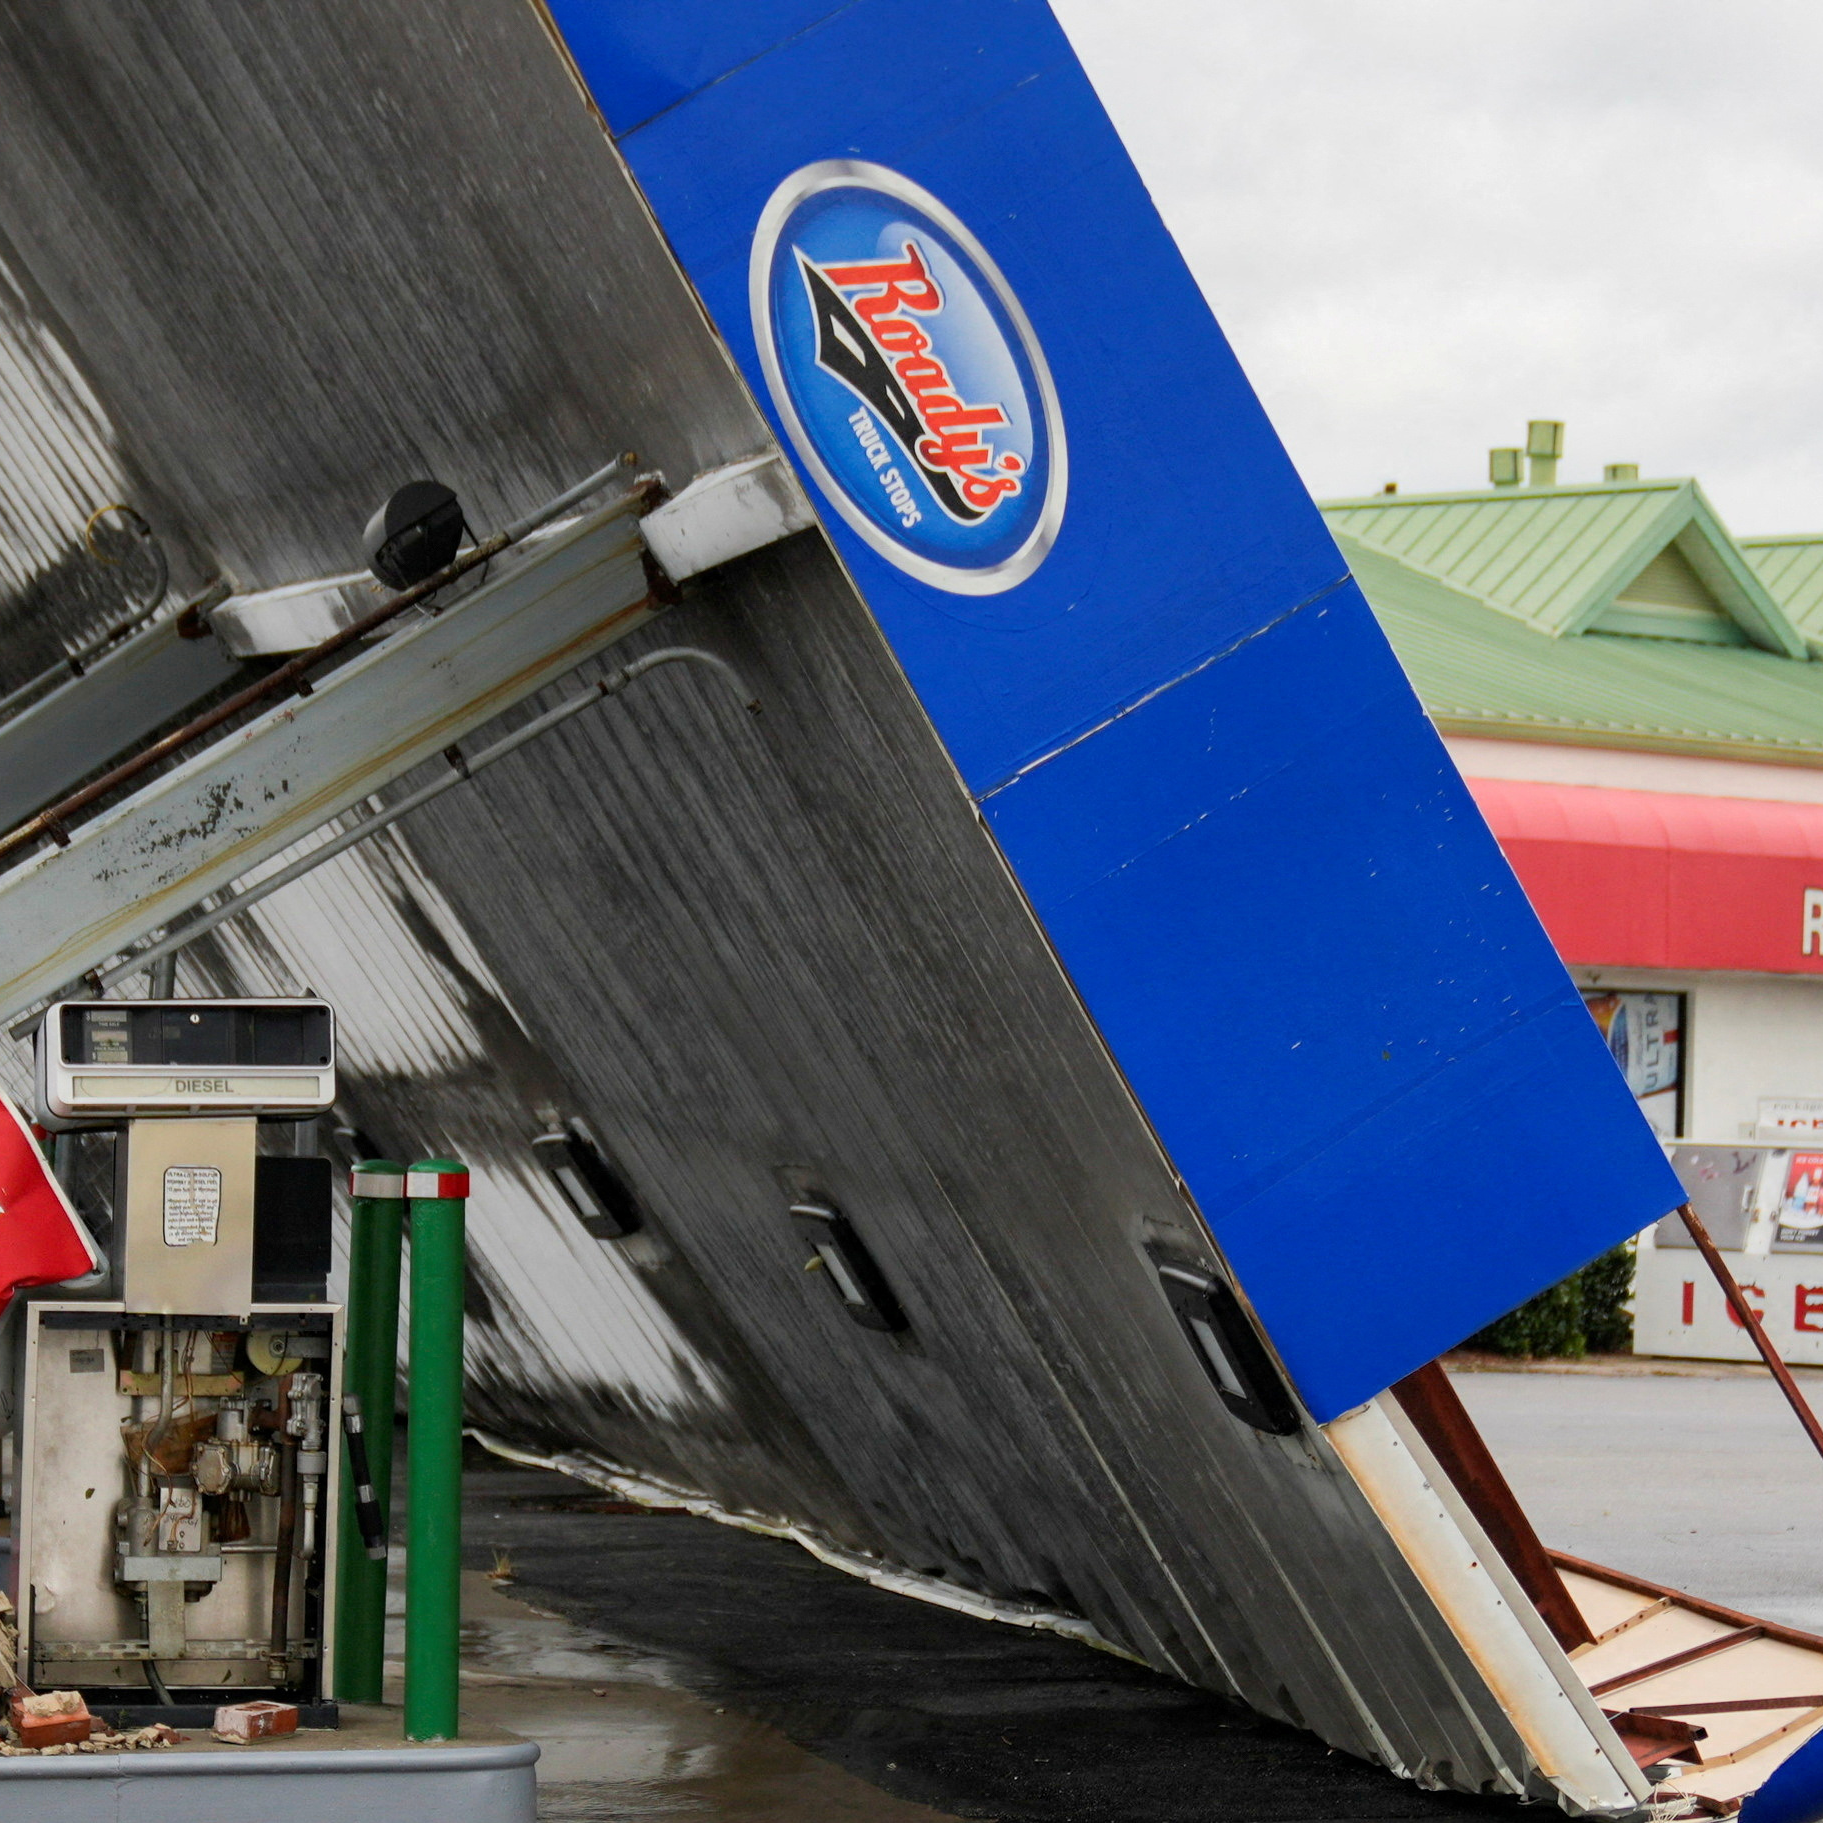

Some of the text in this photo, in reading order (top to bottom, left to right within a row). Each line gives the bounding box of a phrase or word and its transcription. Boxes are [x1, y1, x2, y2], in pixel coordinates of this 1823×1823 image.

[821, 238, 1022, 513] Roady's
[848, 406, 923, 530] TRUCK STOPS
[175, 1079, 234, 1093] DIESEL
